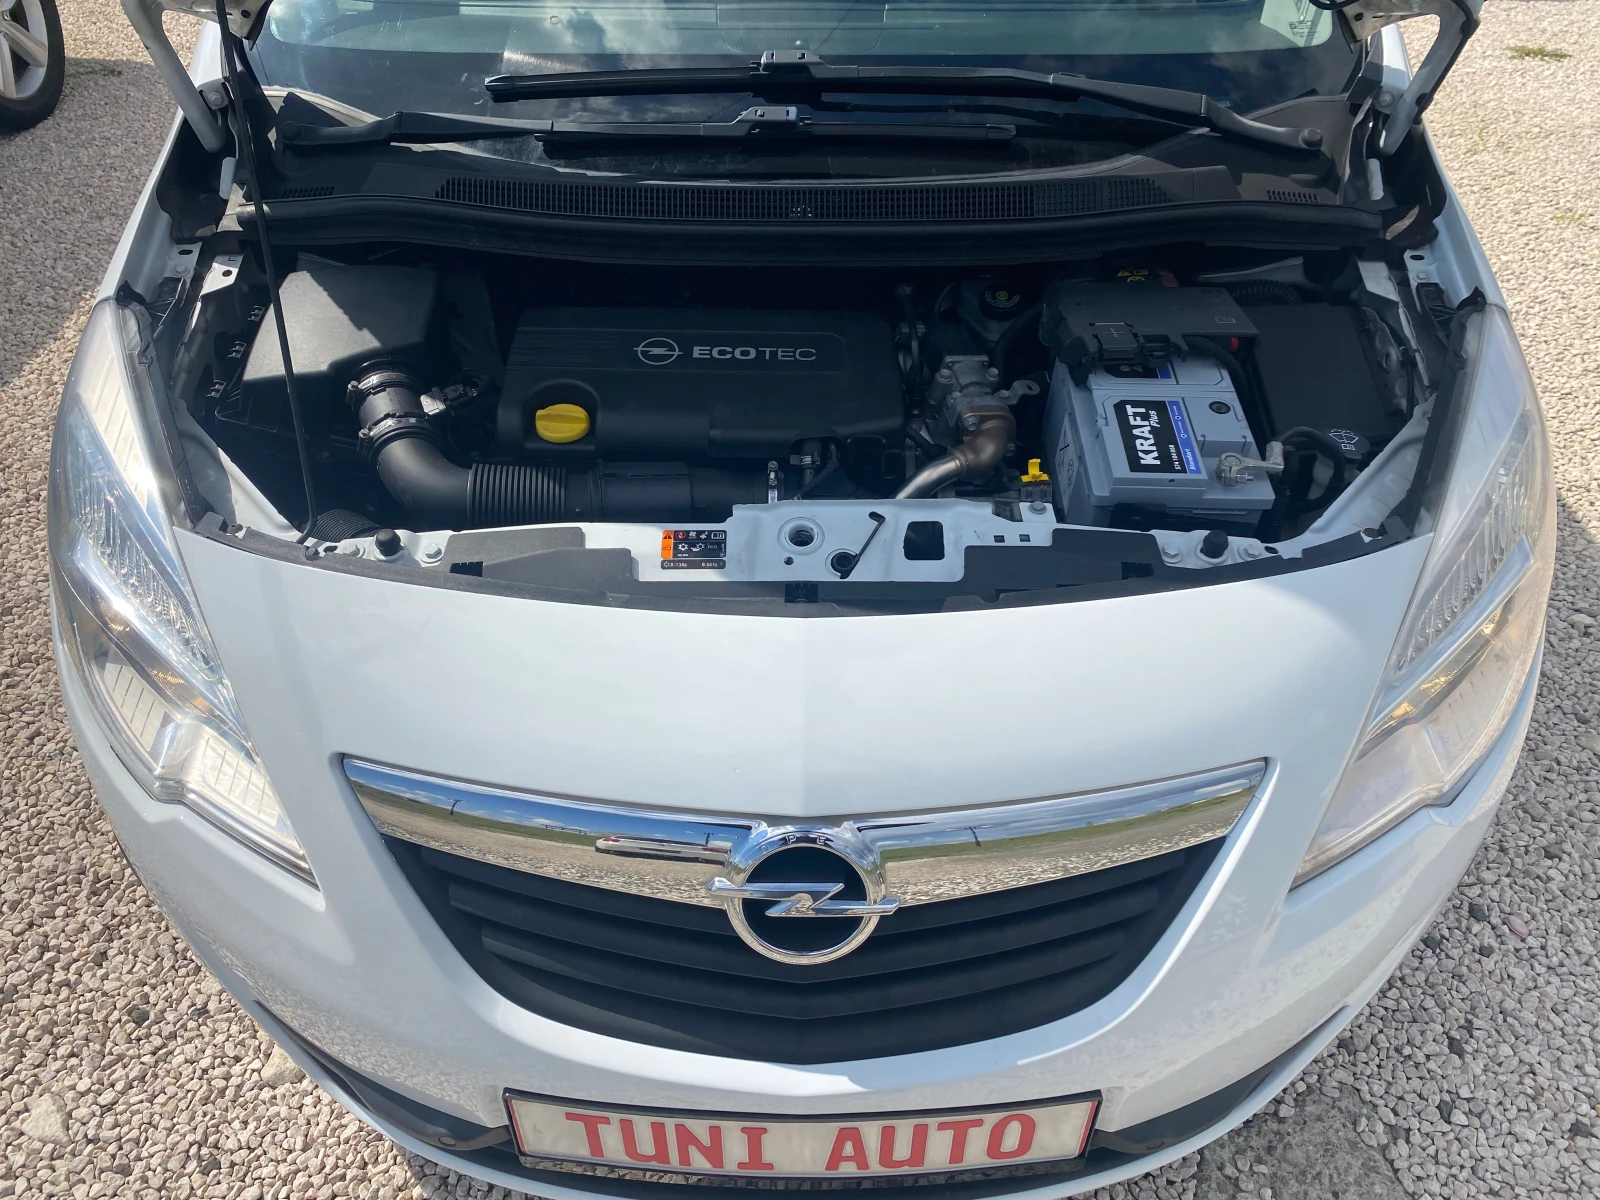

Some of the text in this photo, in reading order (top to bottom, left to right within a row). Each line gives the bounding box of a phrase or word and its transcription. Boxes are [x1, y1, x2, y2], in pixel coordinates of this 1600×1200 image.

[692, 345, 817, 361] ECOTEC
[1125, 404, 1161, 465] KRAFT
[1149, 410, 1161, 428] Plus
[564, 1111, 1038, 1172] TUNI AUTO
